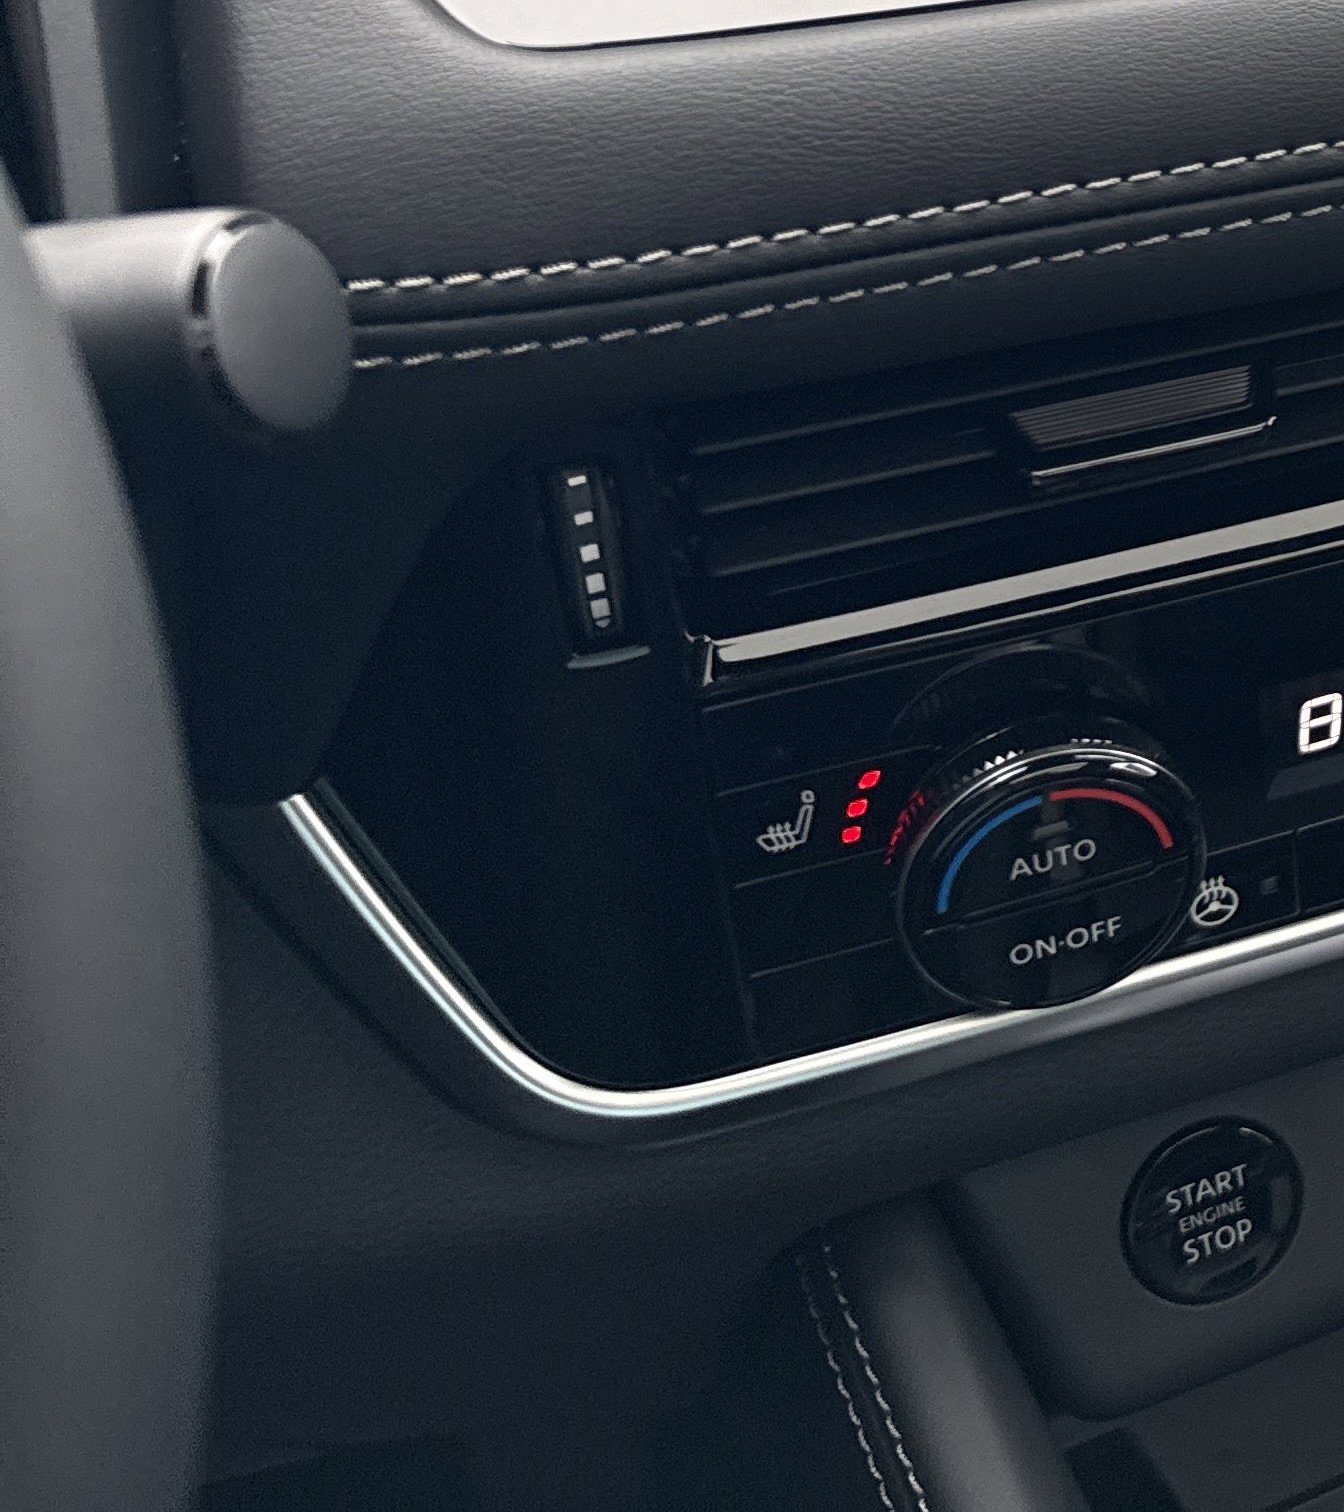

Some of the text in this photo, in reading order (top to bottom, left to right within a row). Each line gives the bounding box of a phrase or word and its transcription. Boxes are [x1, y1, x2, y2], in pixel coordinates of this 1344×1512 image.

[1009, 839, 1097, 881] AUTO
[1165, 1165, 1247, 1215] START
[1178, 1196, 1246, 1233] ENGINE
[1182, 1218, 1253, 1266] STOP
